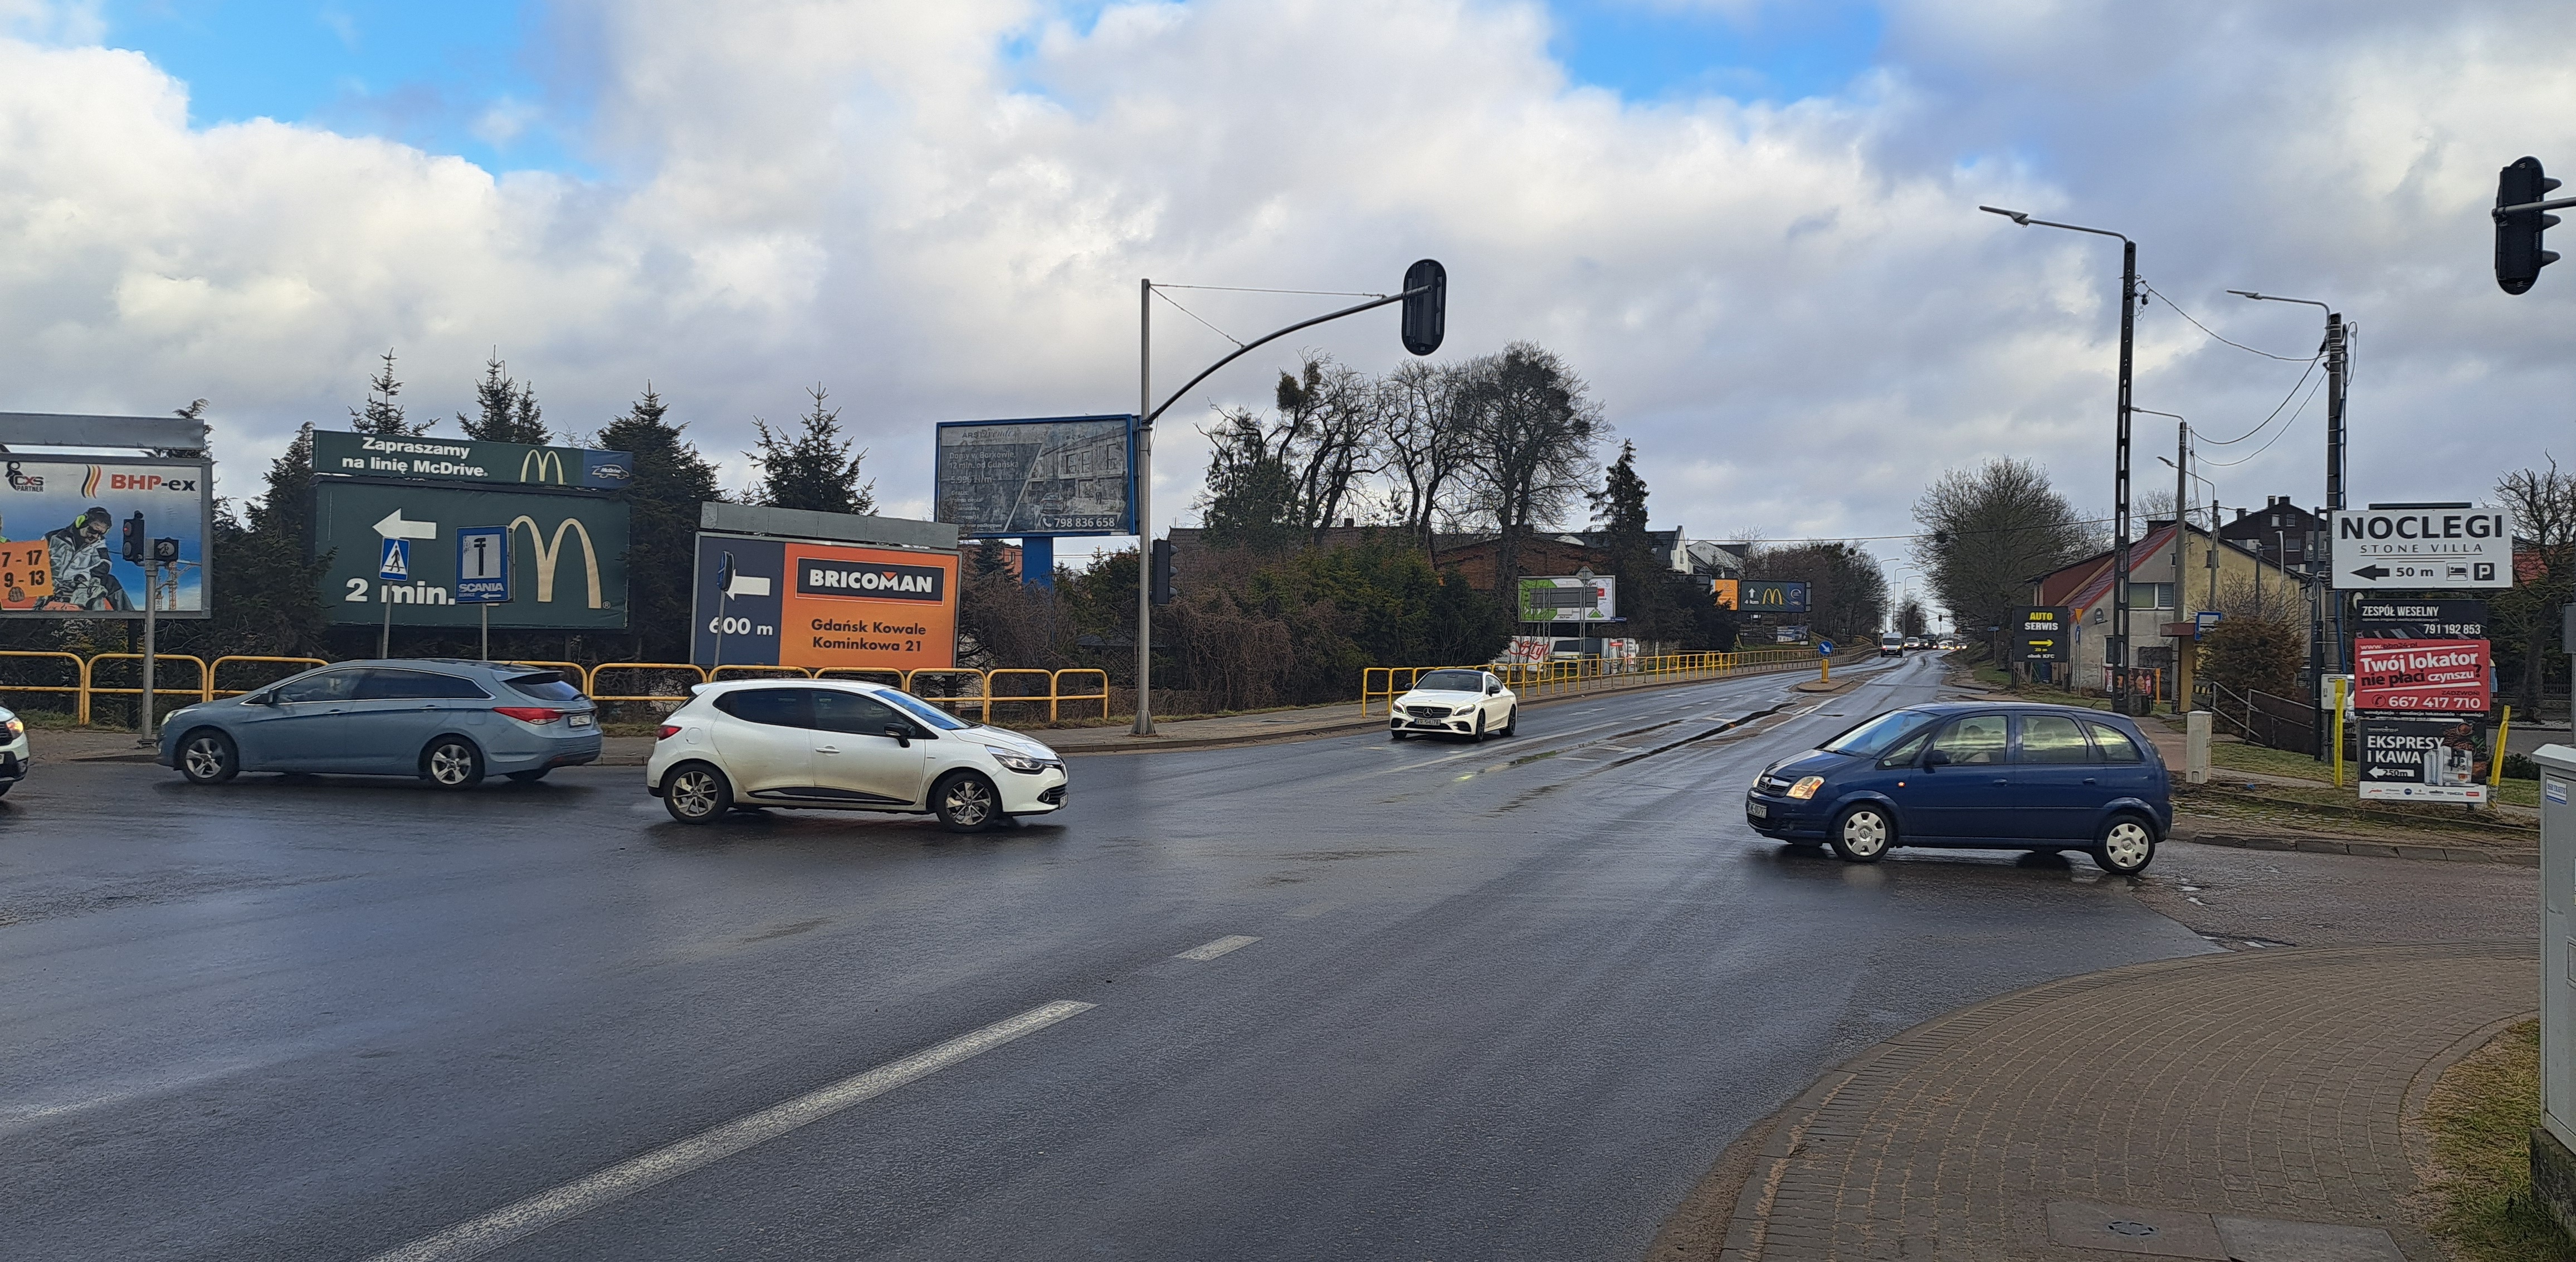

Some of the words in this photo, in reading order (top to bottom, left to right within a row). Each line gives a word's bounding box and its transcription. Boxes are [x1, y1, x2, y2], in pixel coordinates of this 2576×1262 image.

[362, 436, 471, 460] Zapraszamy
[949, 452, 972, 460] Domy
[342, 457, 365, 469] na
[370, 456, 408, 474] linię
[413, 460, 489, 477] McDrive.
[987, 460, 1019, 469] Gdańska
[111, 474, 196, 491] BHP-ex
[1054, 518, 1073, 528] 798
[1075, 517, 1094, 527] 836
[1096, 517, 1115, 527] 658
[2341, 515, 2502, 539] NOCLEGI
[2360, 544, 2419, 553] STONE
[2430, 543, 2483, 552] VILLA
[2, 552, 12, 567] 7
[27, 549, 42, 566] 17
[4, 573, 14, 588] 9
[28, 570, 45, 586] 13
[2396, 567, 2415, 577] 50
[458, 582, 505, 593] SCANIA
[809, 569, 933, 593] BRICOMAN
[345, 578, 369, 602] 2
[380, 581, 456, 606] min.
[2029, 612, 2053, 621] AUTO
[2362, 603, 2395, 616] ZESPÓŁ
[2397, 606, 2439, 616] WESELNY
[709, 617, 751, 635] 600
[757, 624, 773, 636] m
[811, 618, 868, 633] Gdańsk
[873, 622, 926, 635] Kowale
[2024, 622, 2058, 631] SERWIS
[2424, 624, 2441, 634] 791
[2444, 624, 2461, 634] 192
[2463, 624, 2481, 634] 853
[813, 636, 900, 651] Kominkowa
[905, 640, 921, 652] 21
[2360, 654, 2406, 673] Twój
[2408, 652, 2479, 669] lokator
[2361, 673, 2385, 686] nie
[2389, 669, 2425, 688] płaci
[2388, 696, 2418, 707] 667
[2423, 697, 2449, 708] 417
[2453, 698, 2481, 709] 710
[2367, 735, 2445, 749] EKSPRESY
[2367, 750, 2372, 762] I
[2375, 750, 2422, 764] KAWA
